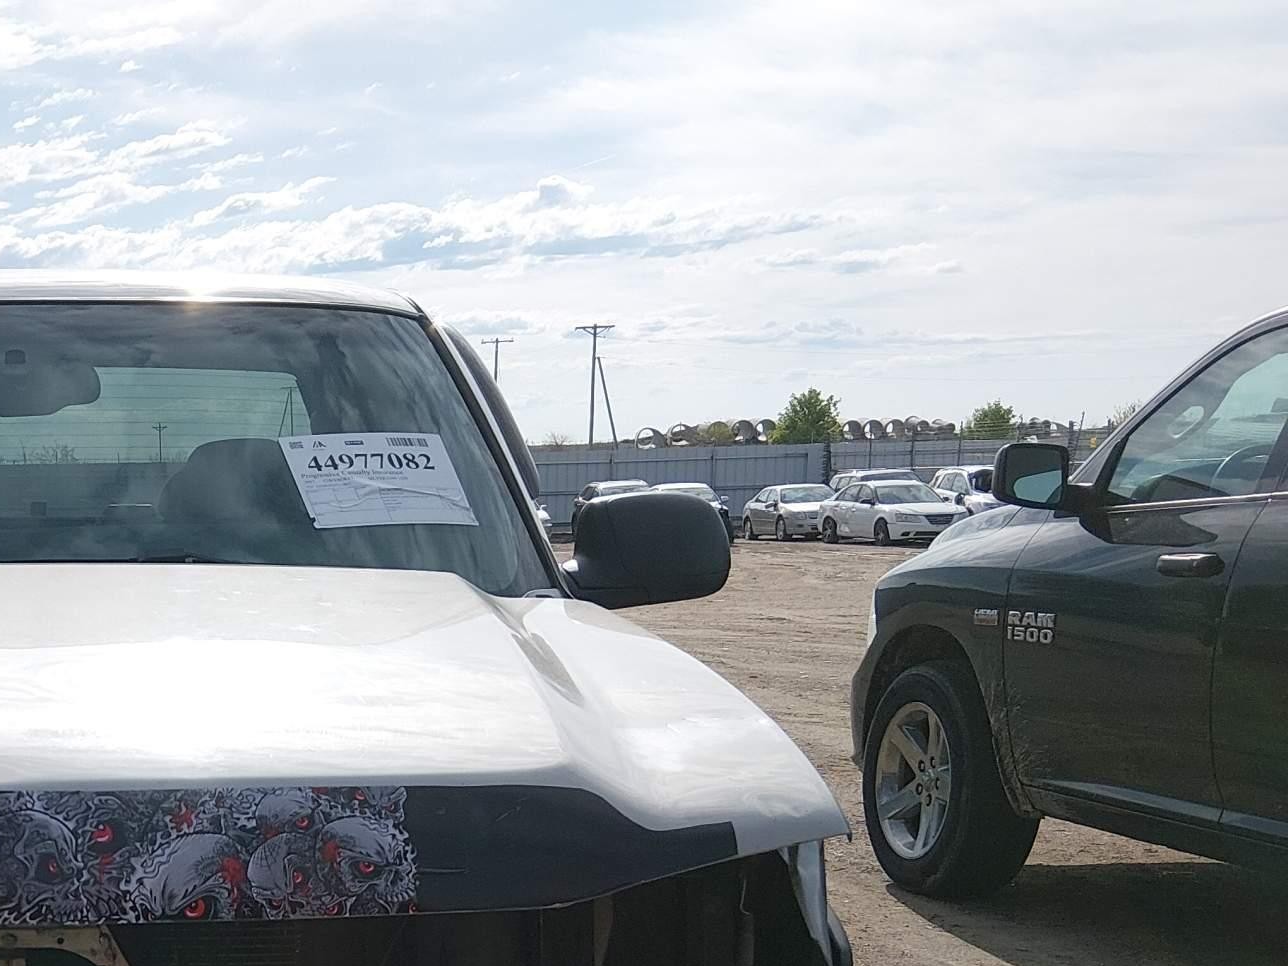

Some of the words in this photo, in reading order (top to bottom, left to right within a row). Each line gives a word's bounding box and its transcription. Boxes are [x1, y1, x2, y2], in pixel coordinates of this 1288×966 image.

[307, 453, 436, 471] 44977082
[1007, 610, 1057, 628] RAM
[1007, 626, 1054, 644] 1500
